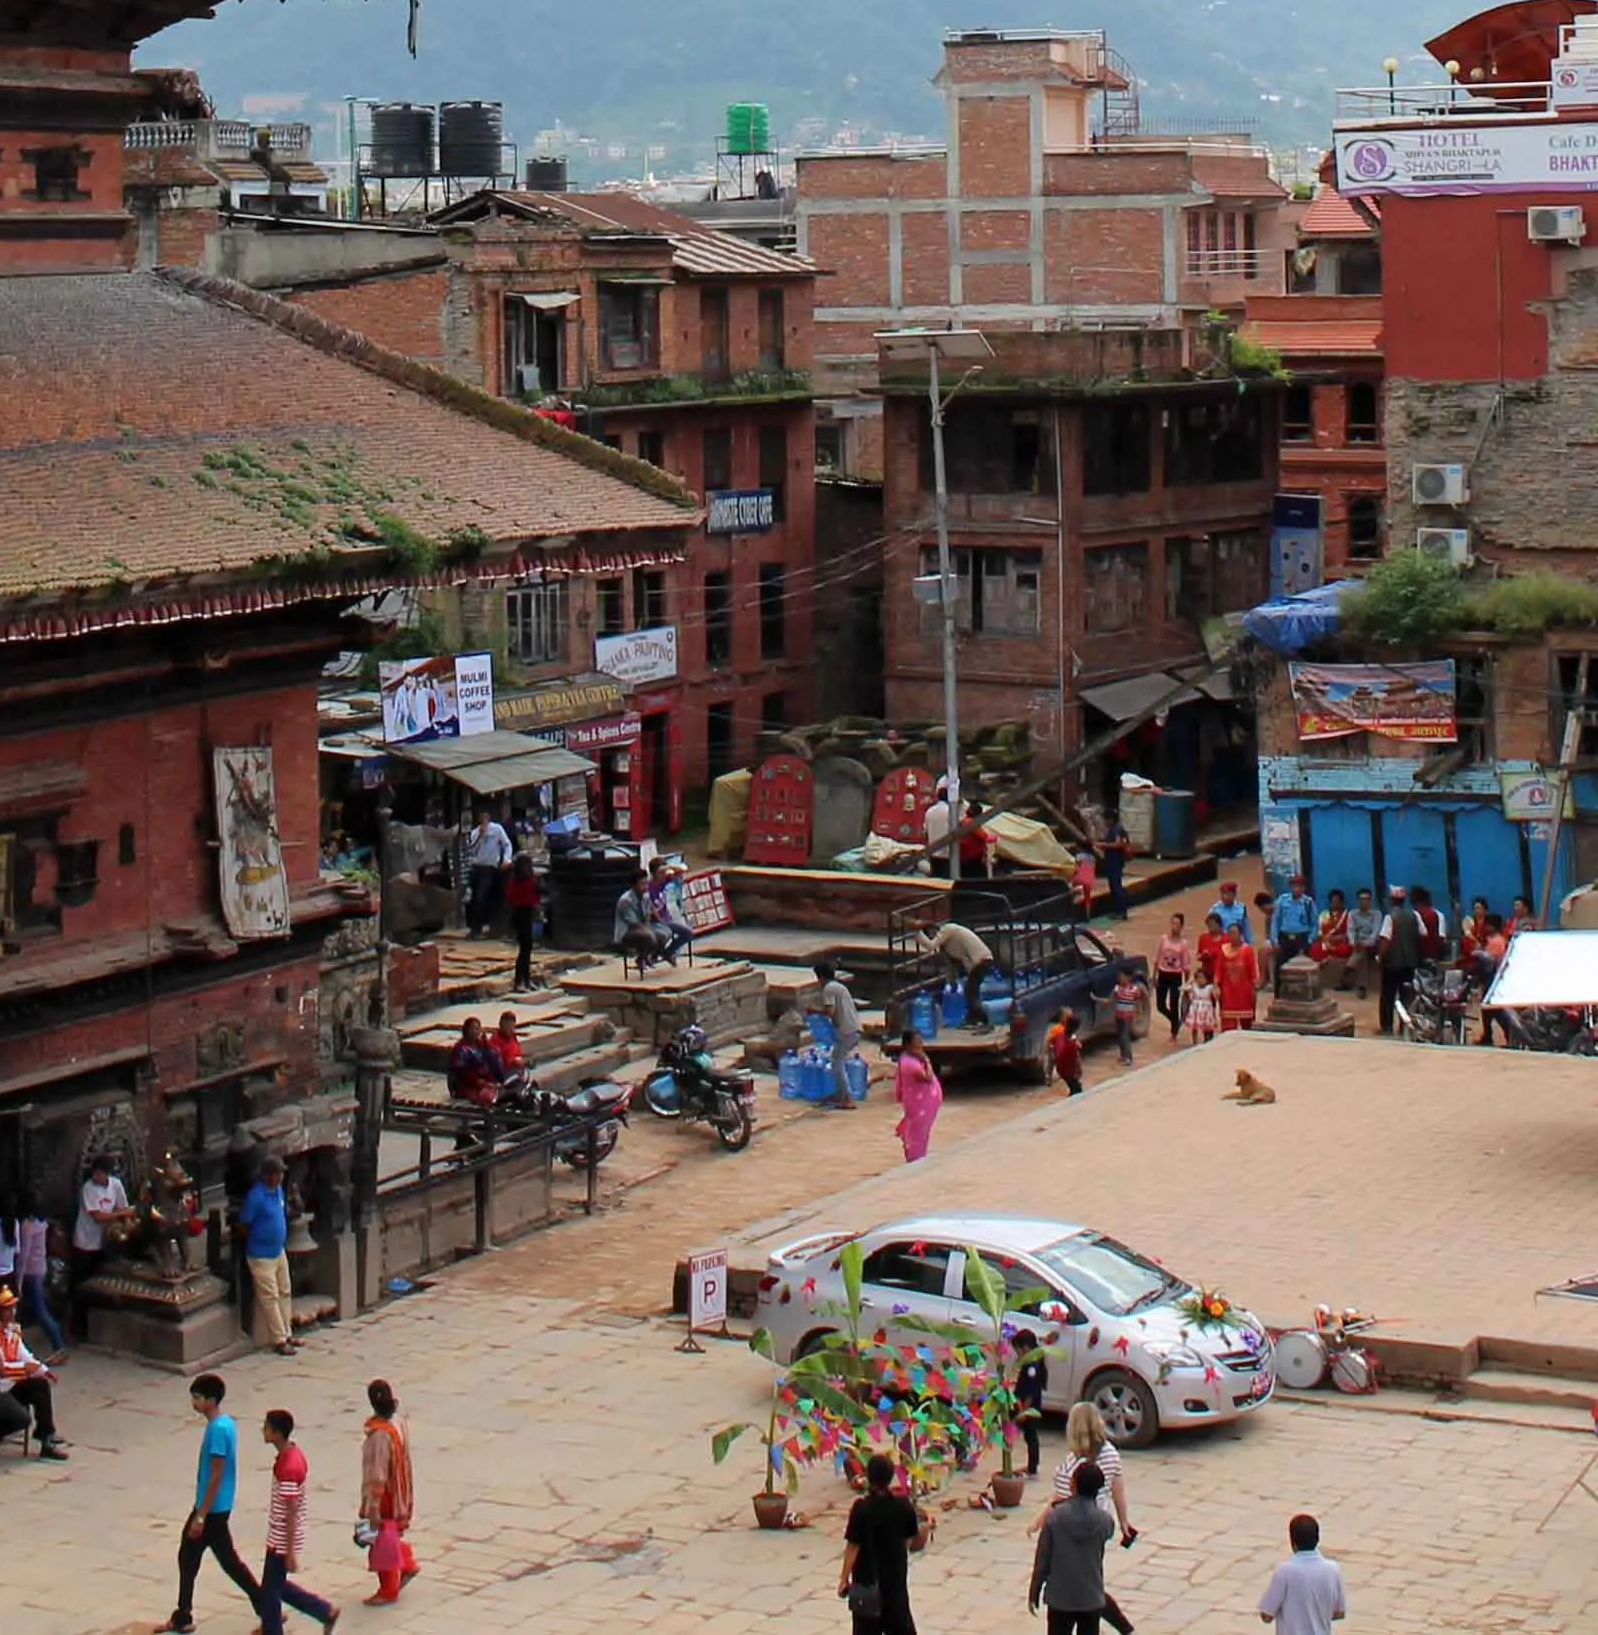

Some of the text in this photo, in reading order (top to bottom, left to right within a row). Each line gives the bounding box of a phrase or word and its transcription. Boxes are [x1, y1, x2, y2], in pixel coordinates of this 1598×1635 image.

[1419, 132, 1482, 147] HOTEL
[1549, 135, 1580, 149] Cafe
[460, 671, 488, 683] MULMI
[459, 685, 491, 698] COFFEE
[464, 700, 487, 712] SHOP
